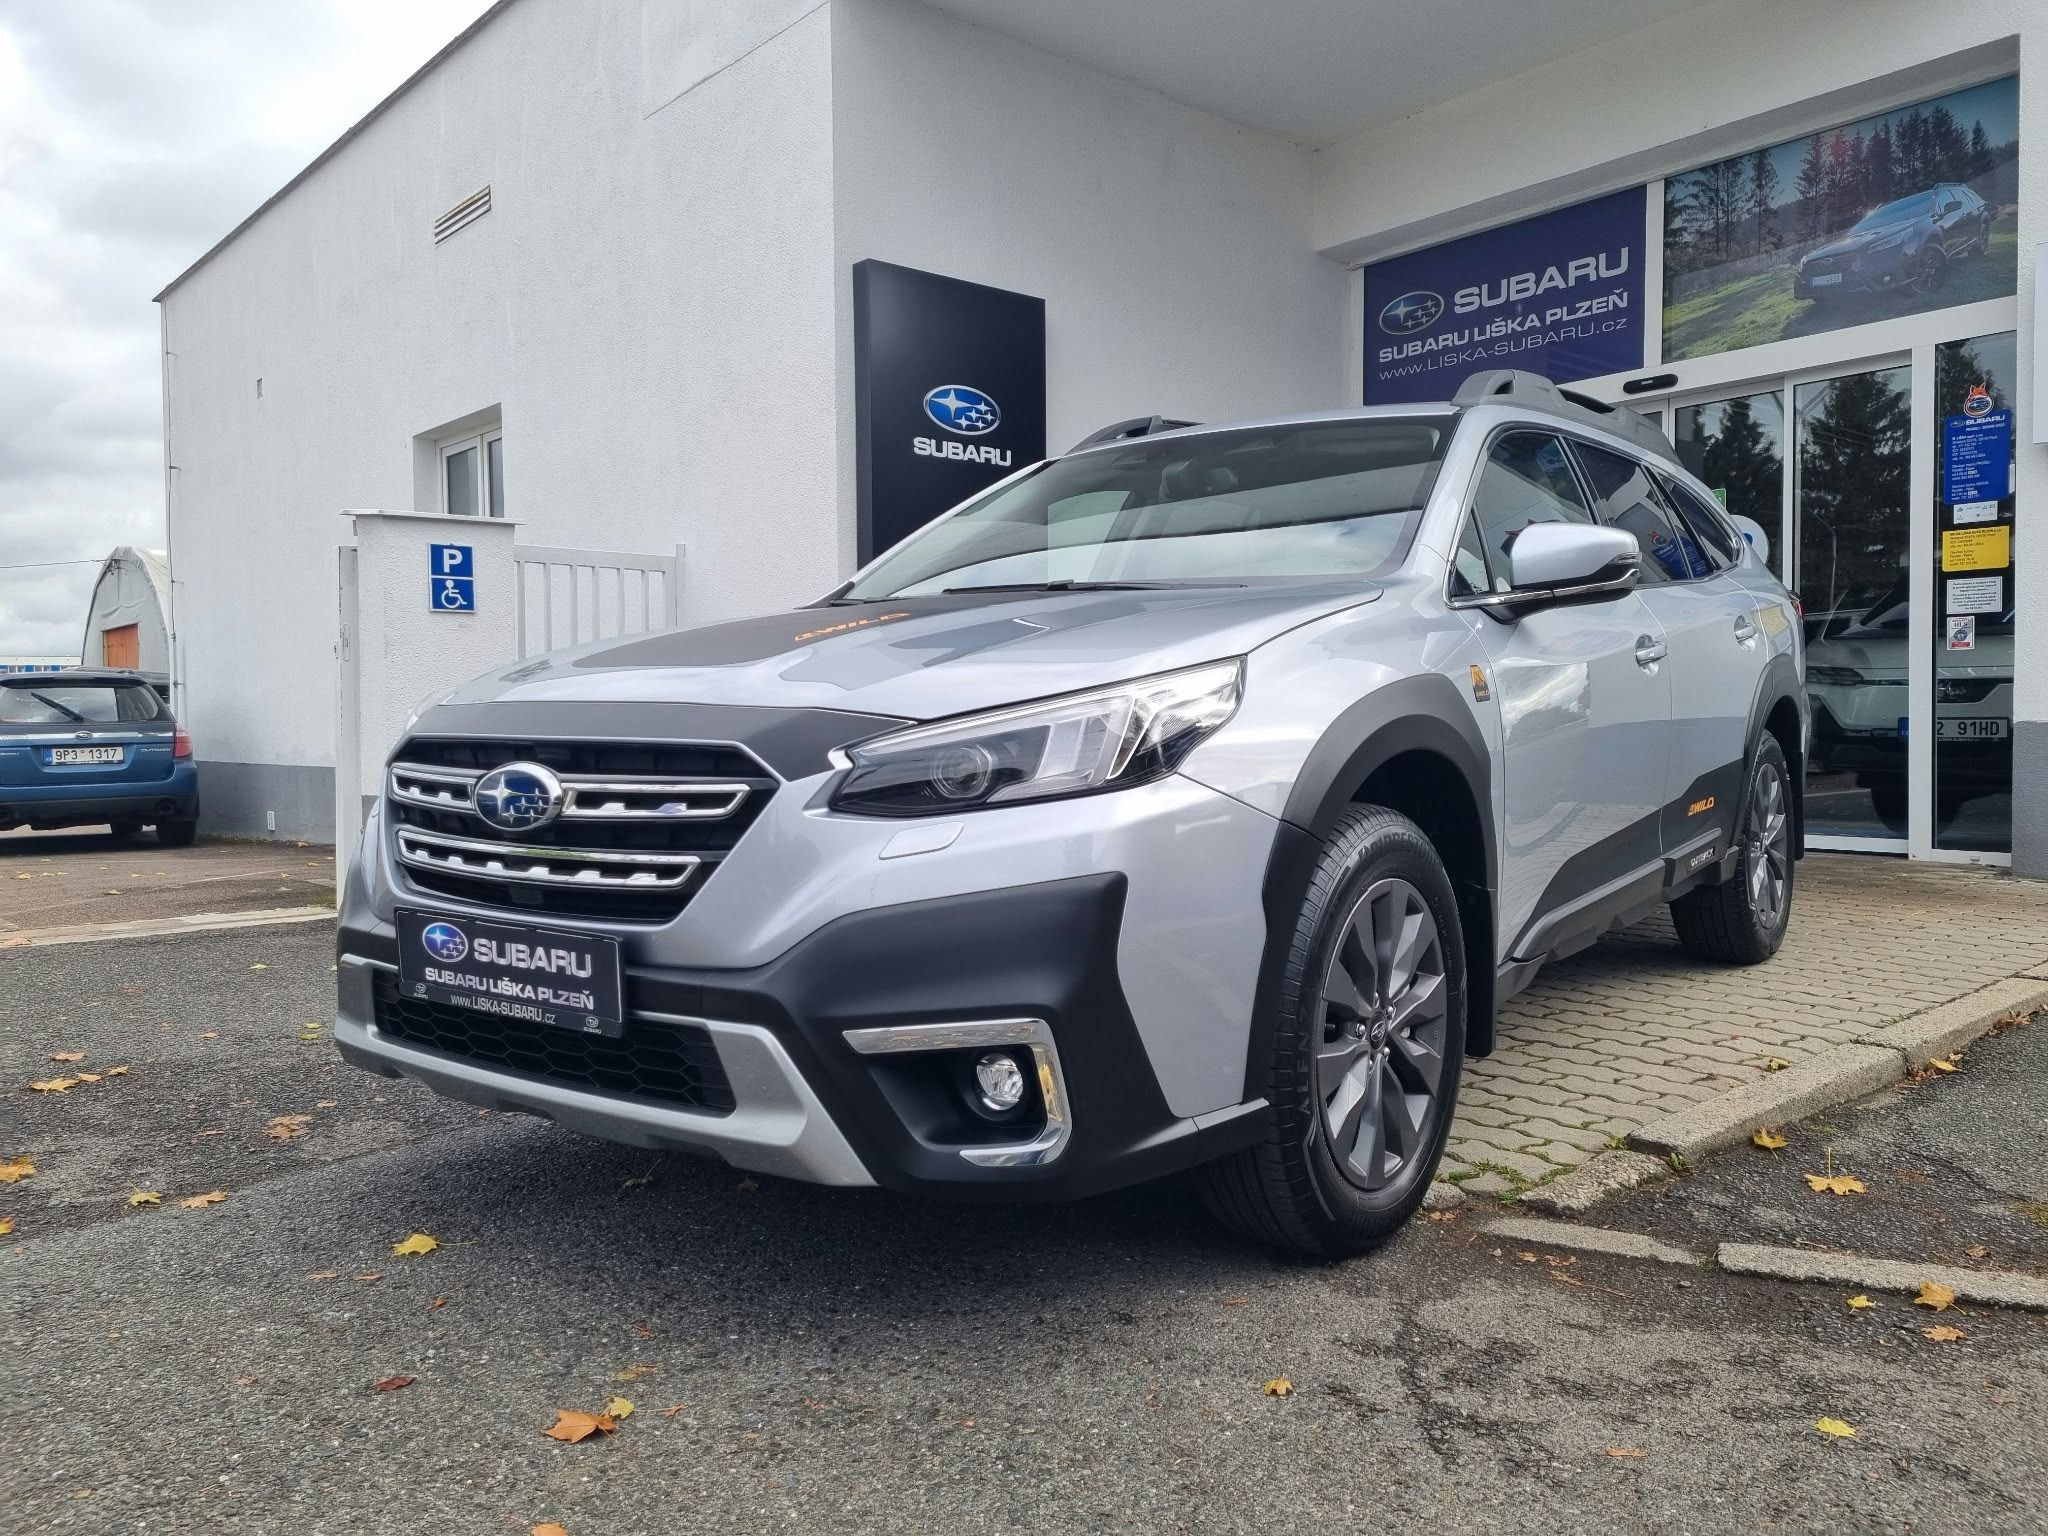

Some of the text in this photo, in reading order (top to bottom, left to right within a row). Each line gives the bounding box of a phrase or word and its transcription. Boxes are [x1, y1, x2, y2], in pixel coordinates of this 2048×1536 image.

[1454, 247, 1629, 314] SUBARU
[1379, 288, 1628, 363] SUBARU LIŠKA PLZEŇ
[1966, 415, 2005, 425] SUBARU
[913, 437, 1012, 467] SUBARU
[443, 548, 463, 573] P
[1957, 721, 2000, 736] 91HD
[55, 748, 118, 761] 9P3 1317
[473, 937, 592, 978] SUBARU
[425, 967, 595, 1010] SUBARU LIŠKA PLZEŇ
